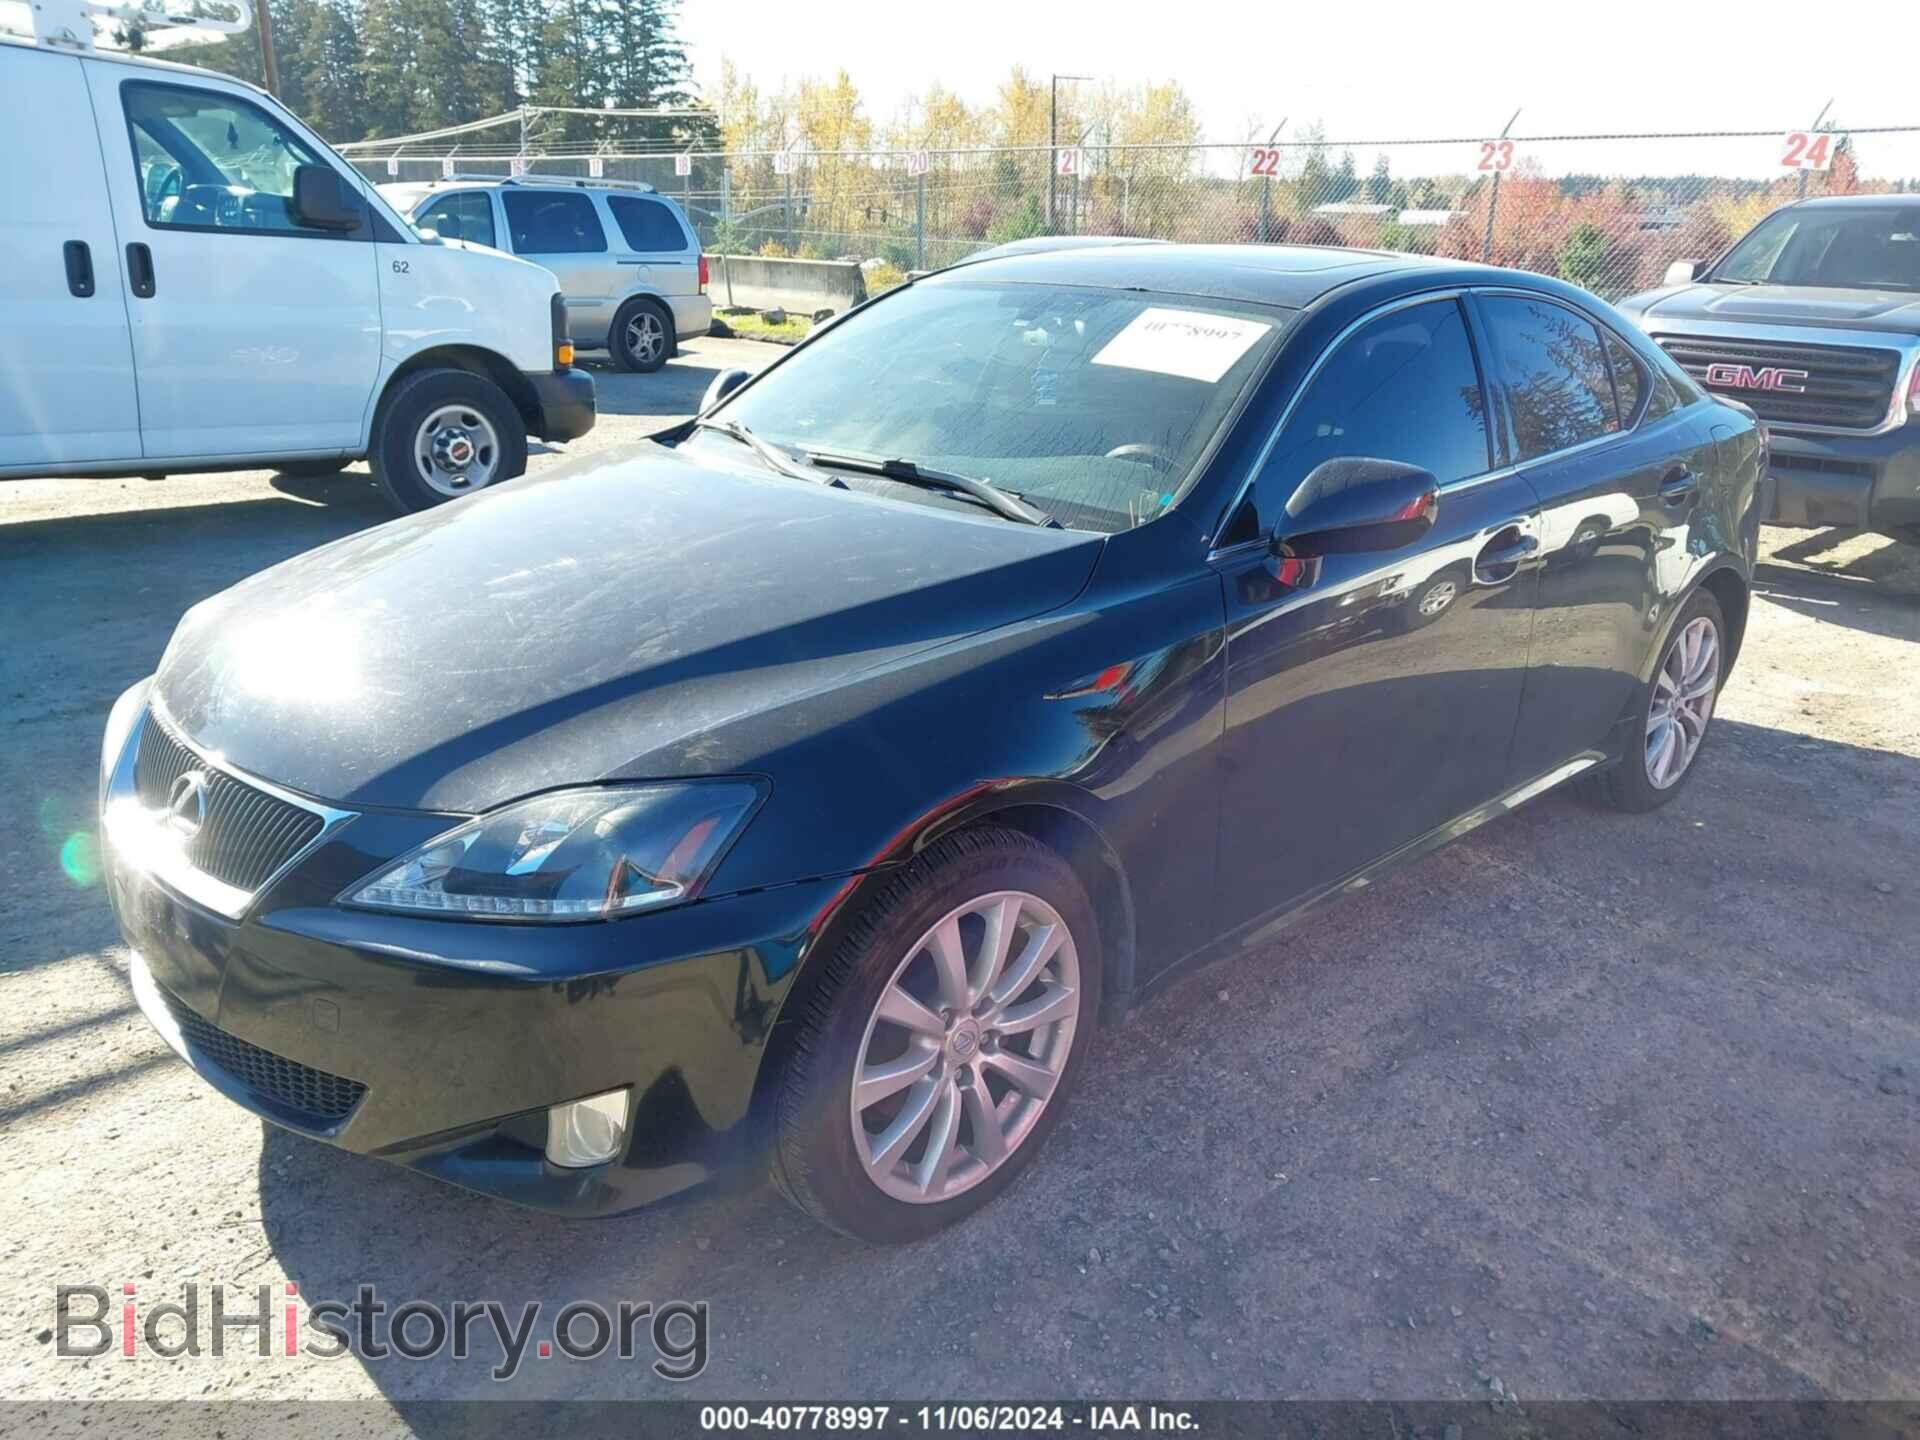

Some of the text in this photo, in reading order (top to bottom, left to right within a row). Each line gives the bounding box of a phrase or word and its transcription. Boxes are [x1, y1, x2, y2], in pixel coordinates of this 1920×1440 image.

[911, 152, 927, 173] 20
[1061, 150, 1078, 172] 21
[1252, 150, 1280, 175] 22
[1478, 141, 1514, 170] 23
[1782, 134, 1831, 168] 24
[392, 260, 410, 273] 62
[1706, 363, 1808, 392] GMC
